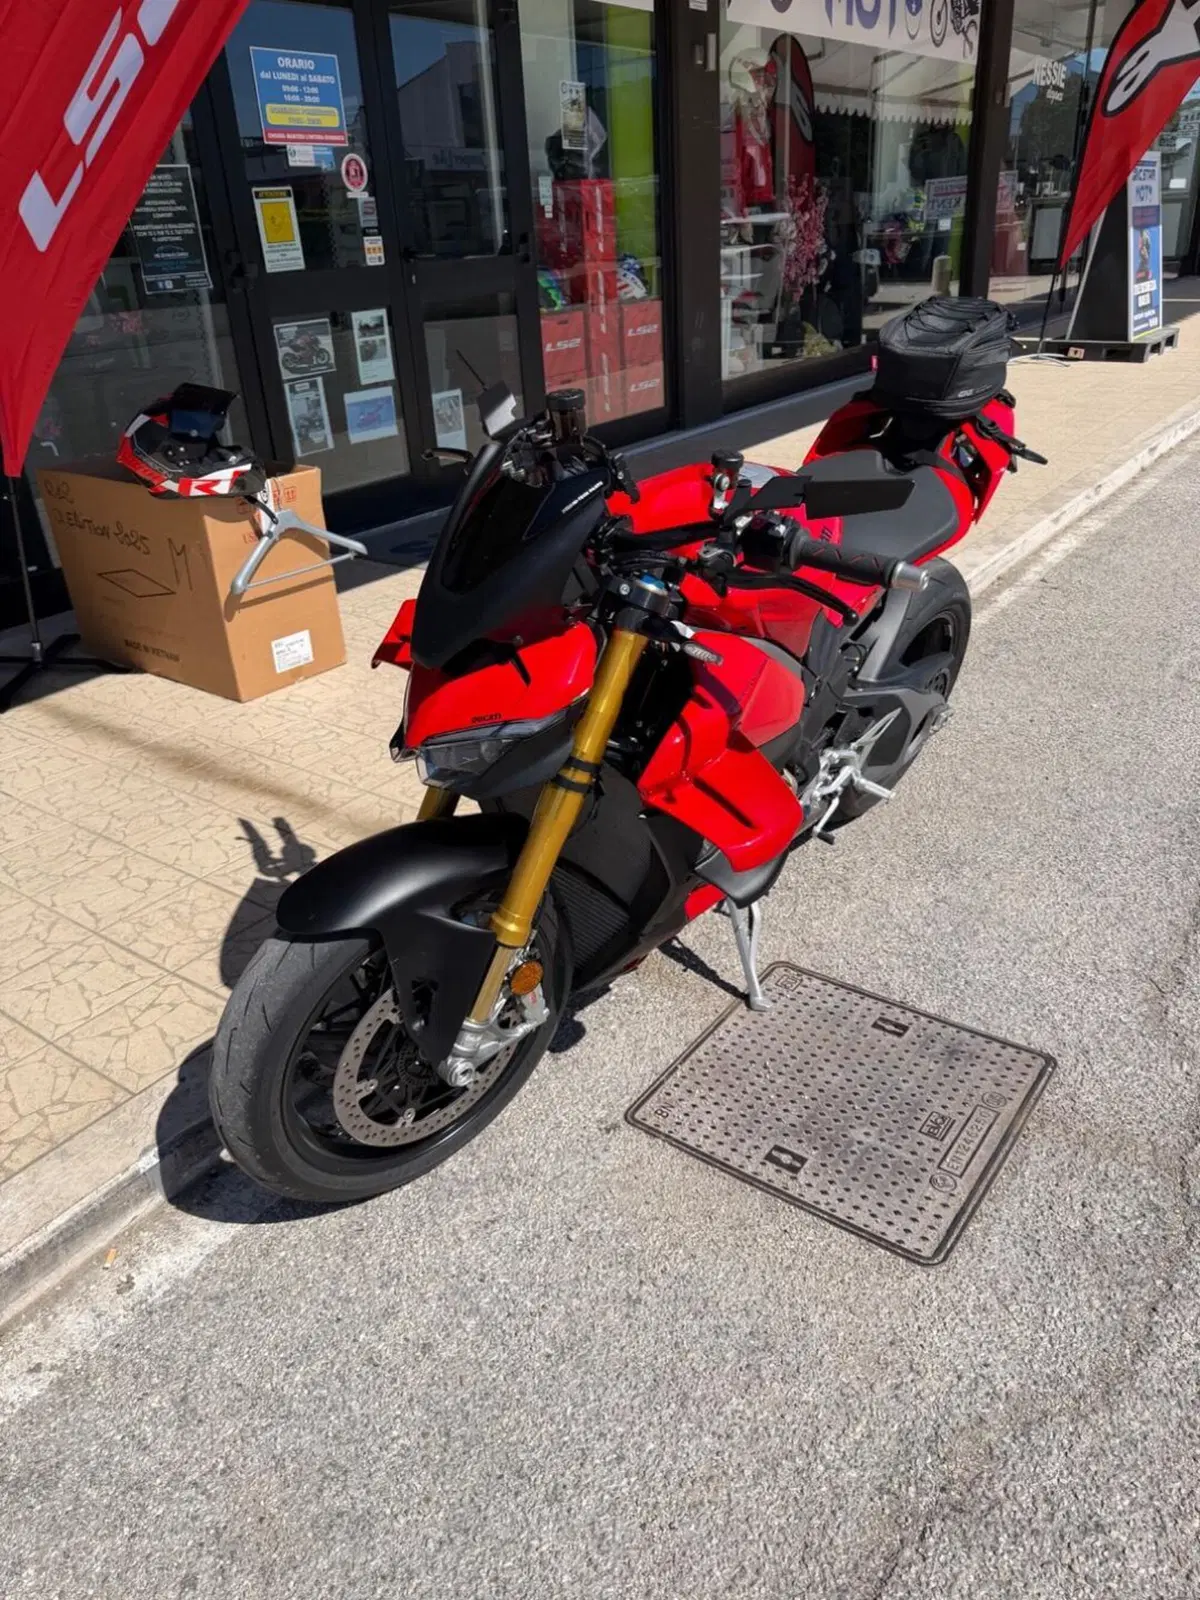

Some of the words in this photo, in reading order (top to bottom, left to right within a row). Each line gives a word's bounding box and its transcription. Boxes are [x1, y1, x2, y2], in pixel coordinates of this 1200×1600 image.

[277, 57, 316, 70] ORARIO
[260, 71, 271, 79] dal
[309, 74, 335, 84] SABATO
[1032, 60, 1067, 88] NESSIE
[628, 324, 660, 337] LS2
[545, 338, 581, 352] LS2
[630, 379, 661, 392] LS2
[471, 712, 502, 723] DUCATI
